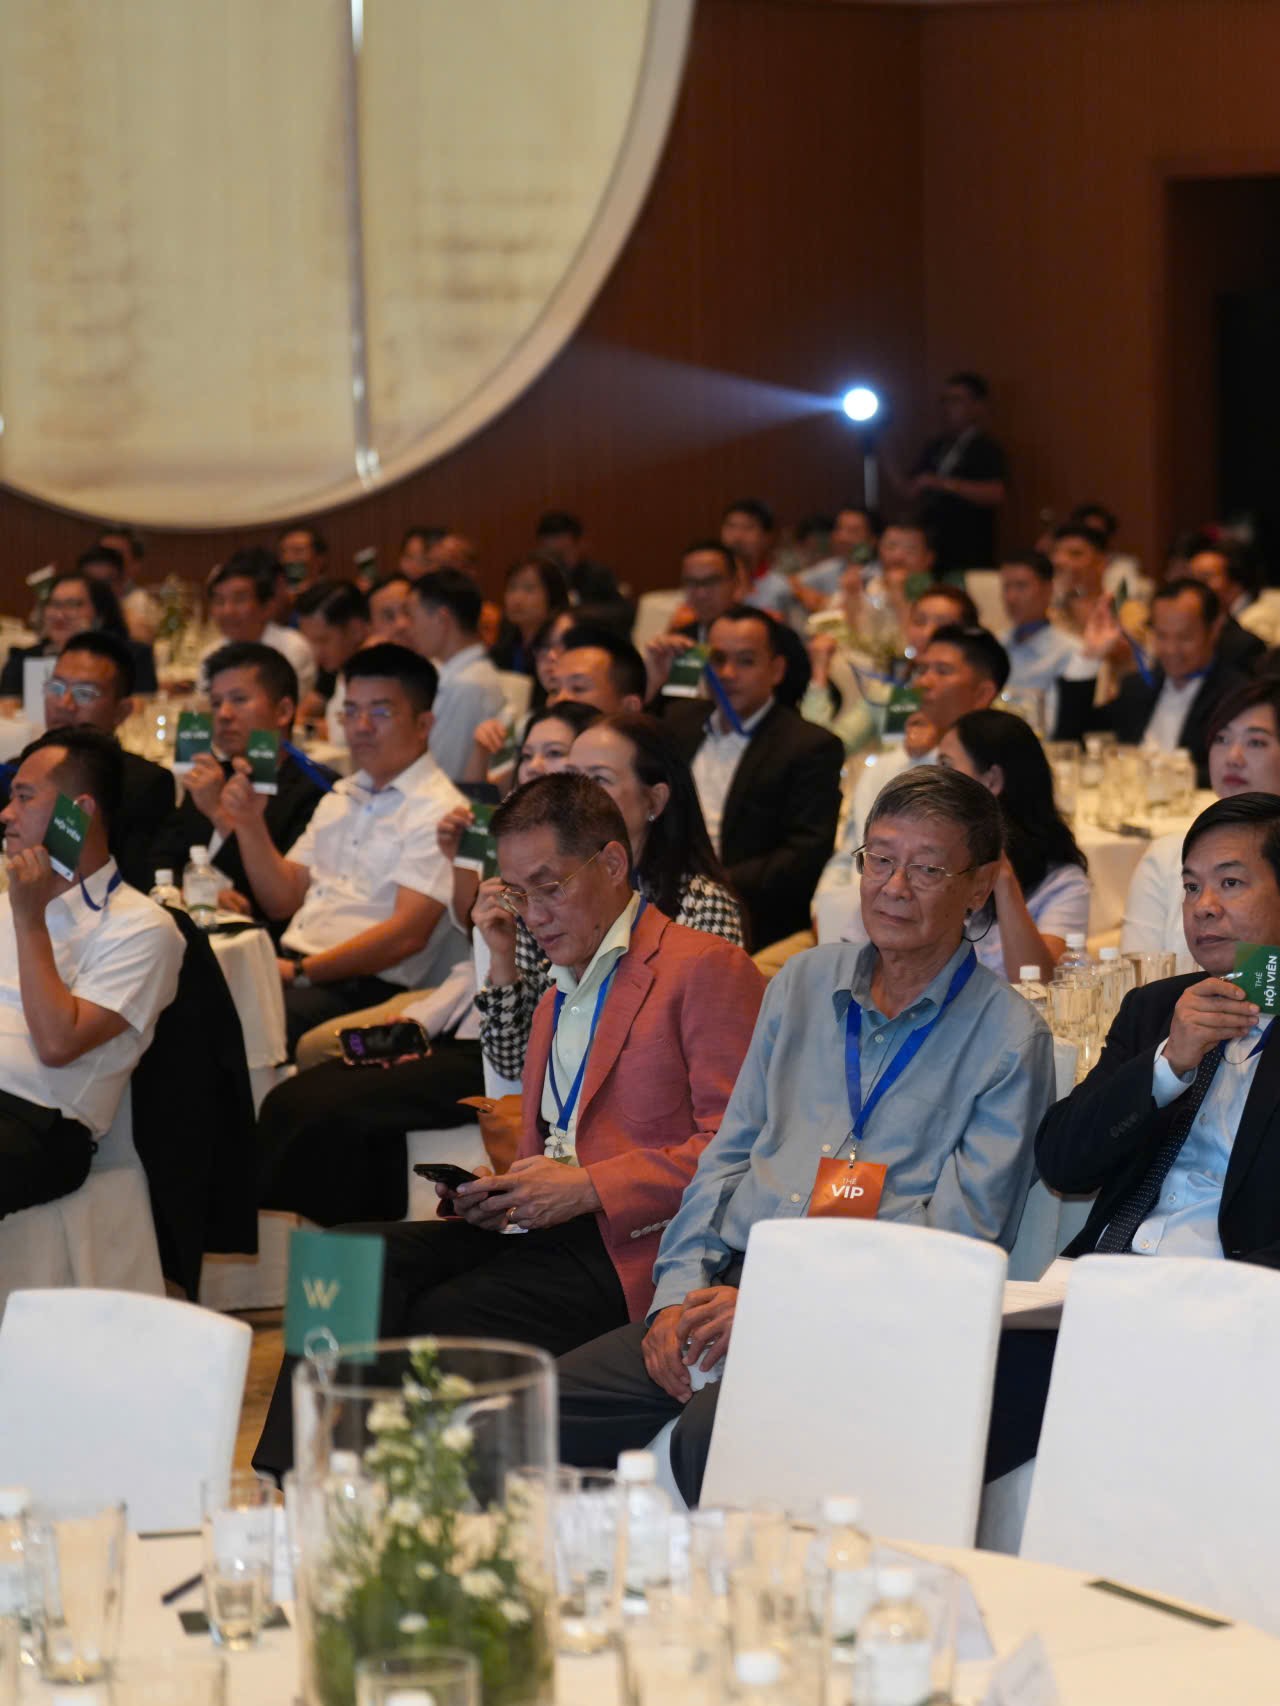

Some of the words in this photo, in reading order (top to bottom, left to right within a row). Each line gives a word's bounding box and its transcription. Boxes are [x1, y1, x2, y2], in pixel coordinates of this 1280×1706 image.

[1265, 955, 1278, 983] VIÊN
[1264, 985, 1277, 1007] HỘI
[831, 1183, 864, 1199] VIP
